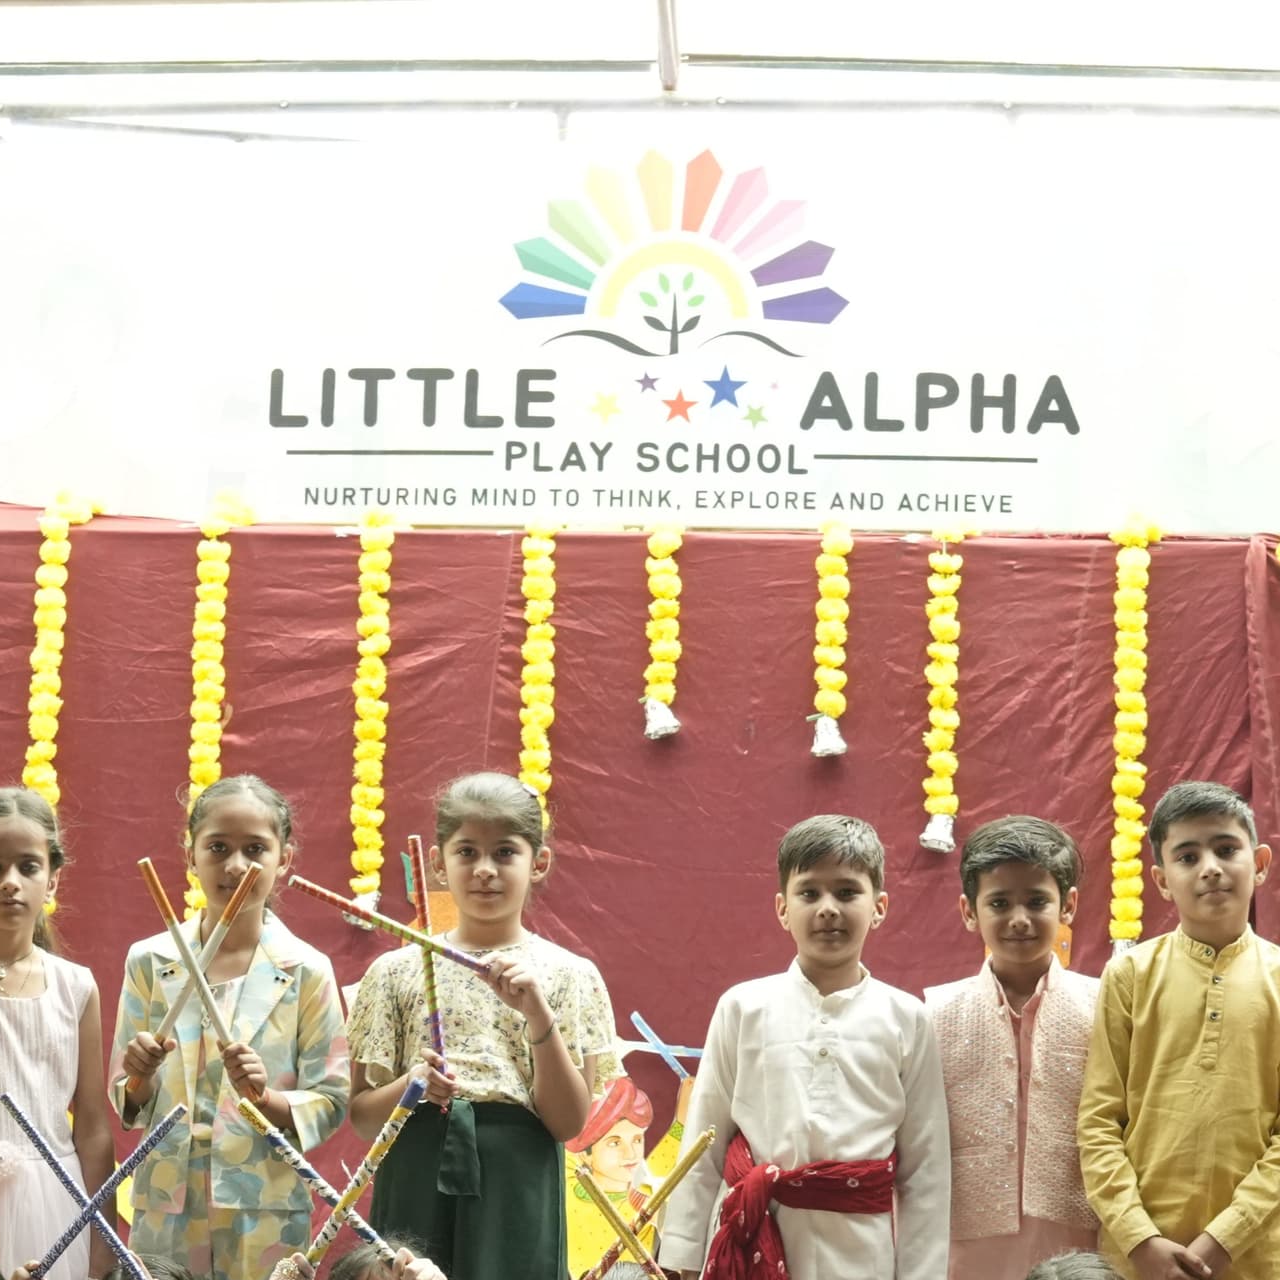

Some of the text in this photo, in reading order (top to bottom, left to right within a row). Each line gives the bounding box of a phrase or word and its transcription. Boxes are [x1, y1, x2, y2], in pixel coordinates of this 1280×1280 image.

[269, 368, 1080, 435] LITTLE ALPHA
[505, 440, 808, 475] PLAY SCHOOL
[304, 487, 1013, 514] NURTURING MIND TO THINK, EXPLORE AND ACHIEVE
